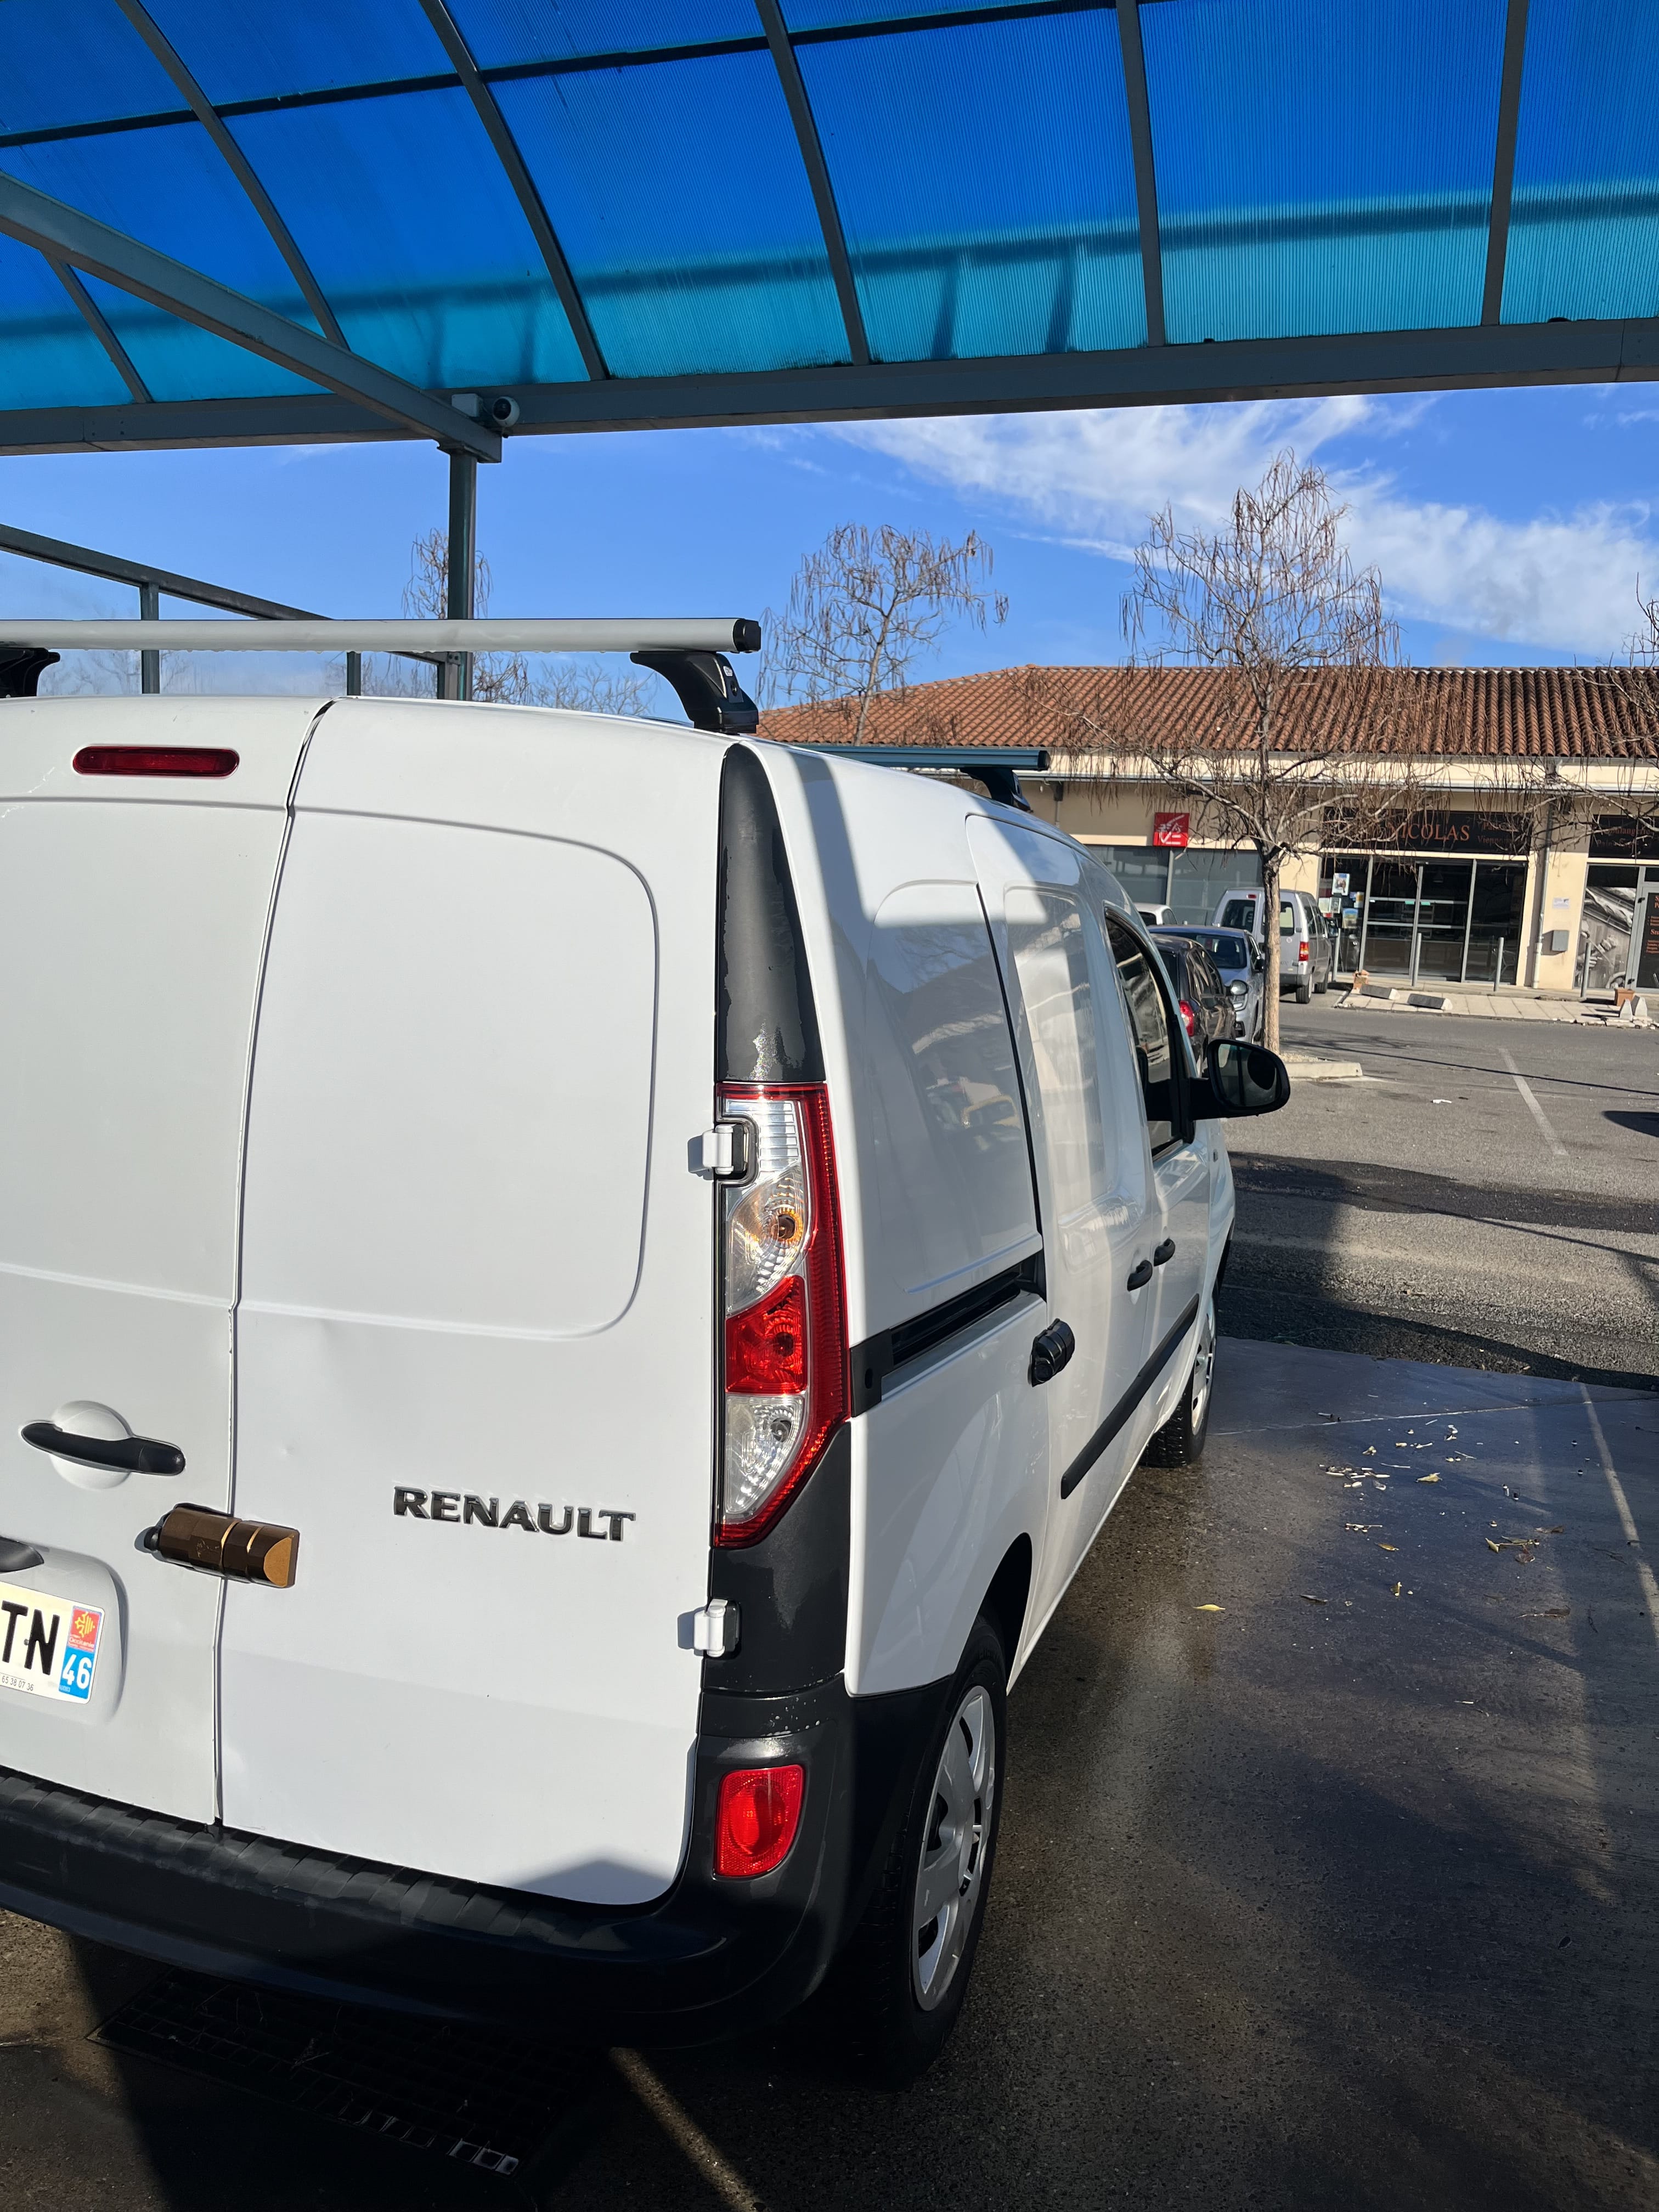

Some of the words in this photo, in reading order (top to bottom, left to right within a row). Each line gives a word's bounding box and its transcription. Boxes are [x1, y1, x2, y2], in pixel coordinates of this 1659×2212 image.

[393, 1485, 636, 1542] RENAULT
[1, 1600, 60, 1675] TN
[2, 1675, 9, 1684] 65
[10, 1678, 17, 1686] 38
[18, 1680, 26, 1689] 07
[26, 1683, 34, 1691] 36
[62, 1654, 92, 1690] 46
